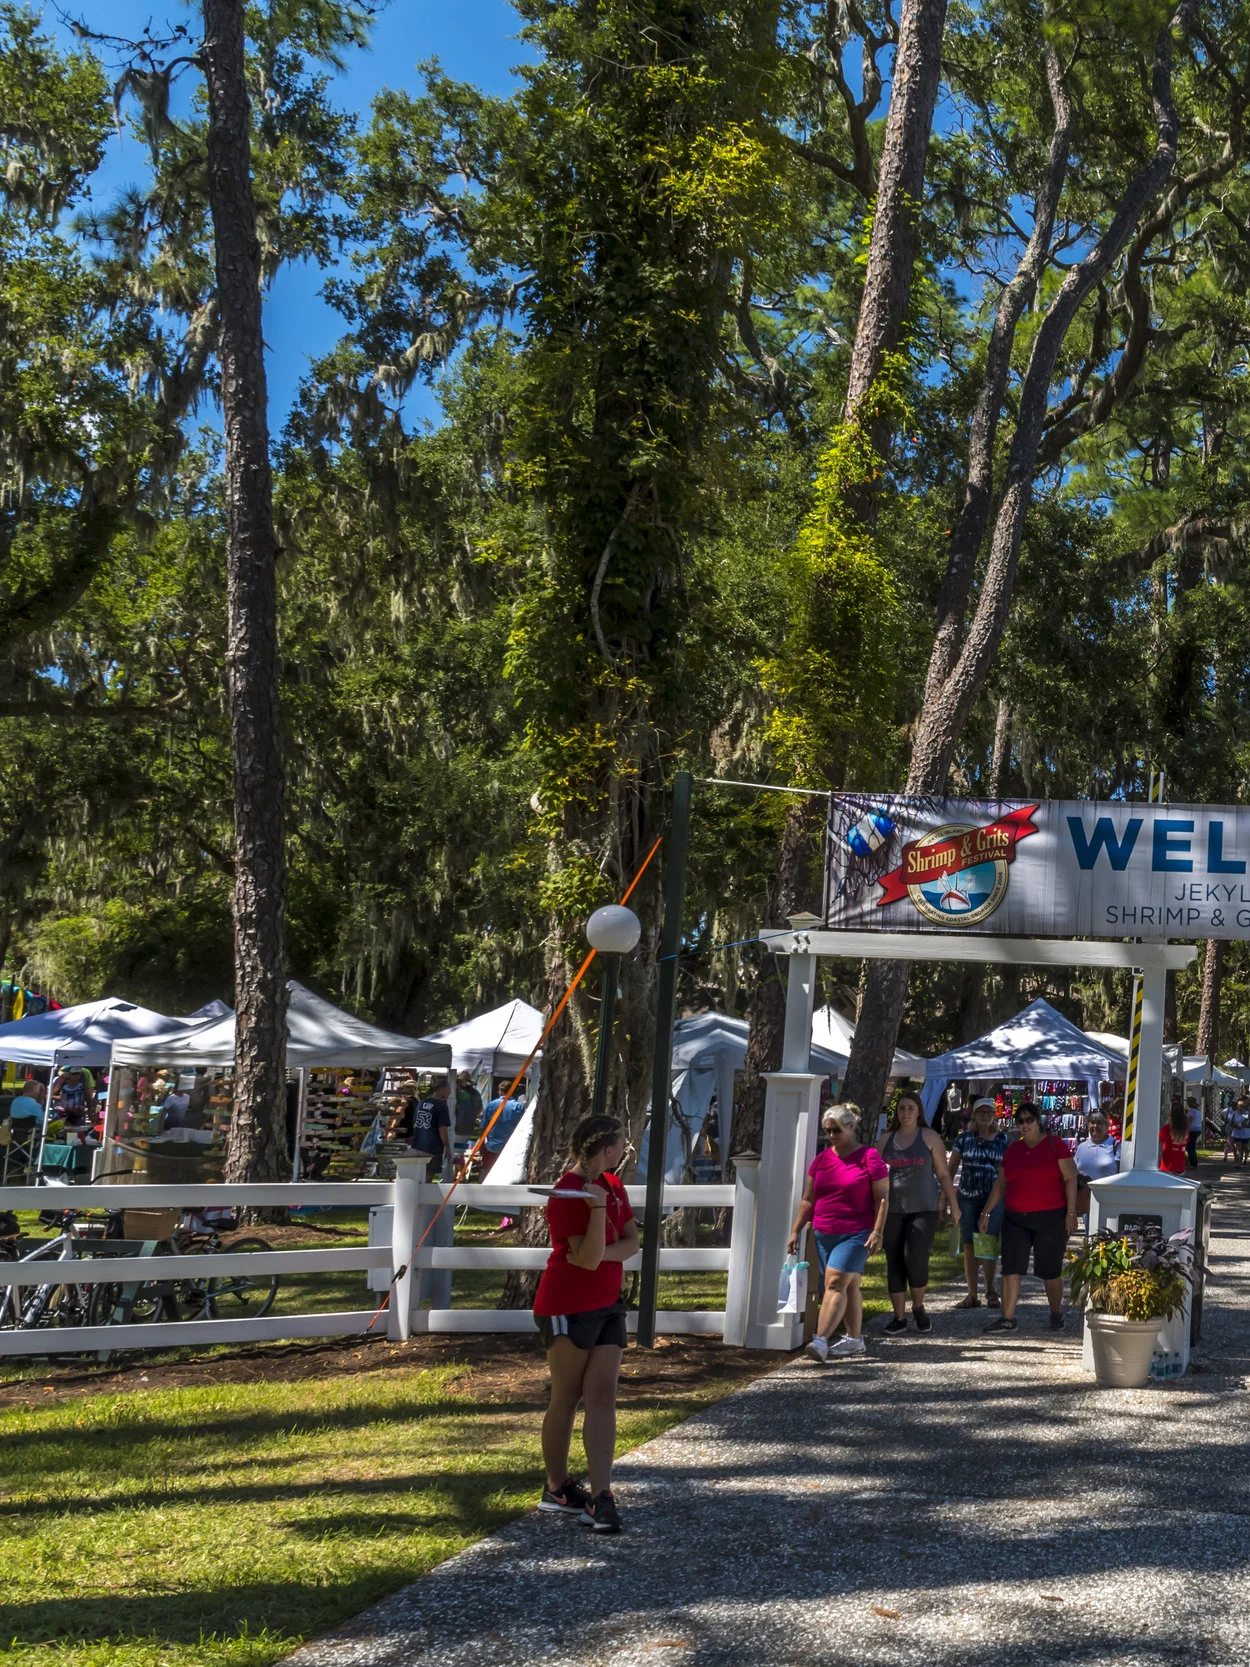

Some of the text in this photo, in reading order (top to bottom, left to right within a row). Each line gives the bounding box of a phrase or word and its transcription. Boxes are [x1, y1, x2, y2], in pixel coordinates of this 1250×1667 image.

[907, 828, 1009, 873] Shrimp & Grits
[961, 849, 1007, 867] FESTIVAL
[971, 902, 992, 919] GEORGIA
[1106, 905, 1200, 926] SHRIMP
[1210, 908, 1225, 927] &
[415, 1110, 433, 1129] 53
